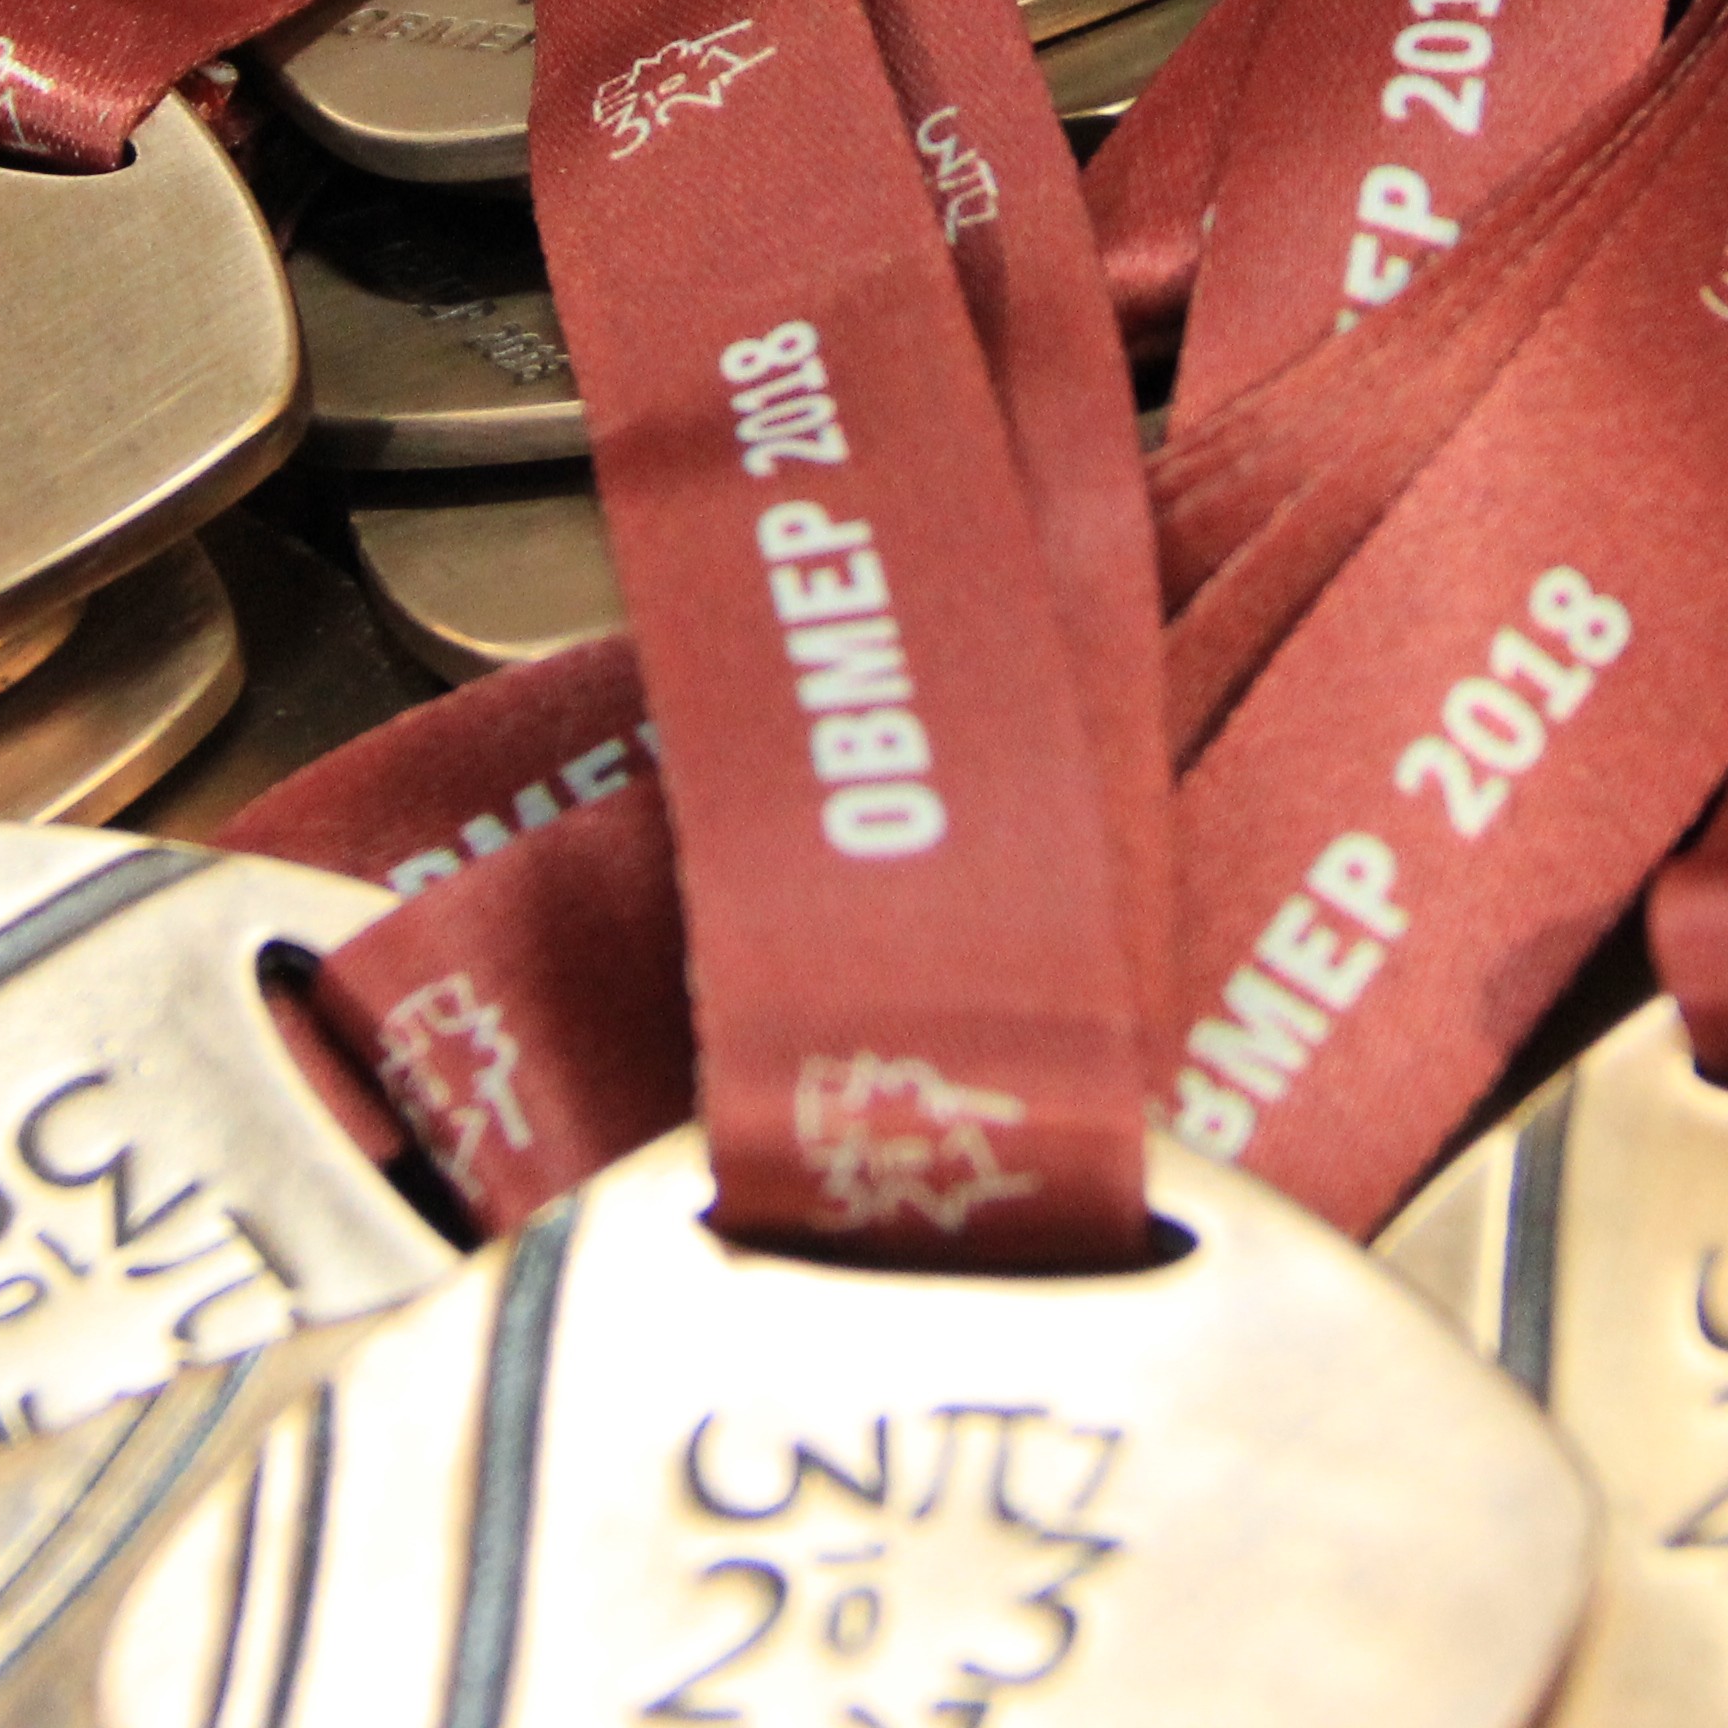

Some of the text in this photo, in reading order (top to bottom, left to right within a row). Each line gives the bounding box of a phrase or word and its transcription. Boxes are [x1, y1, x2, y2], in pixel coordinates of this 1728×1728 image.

[719, 318, 949, 860] OBMEP 2018
[1390, 563, 1632, 840] 2018
